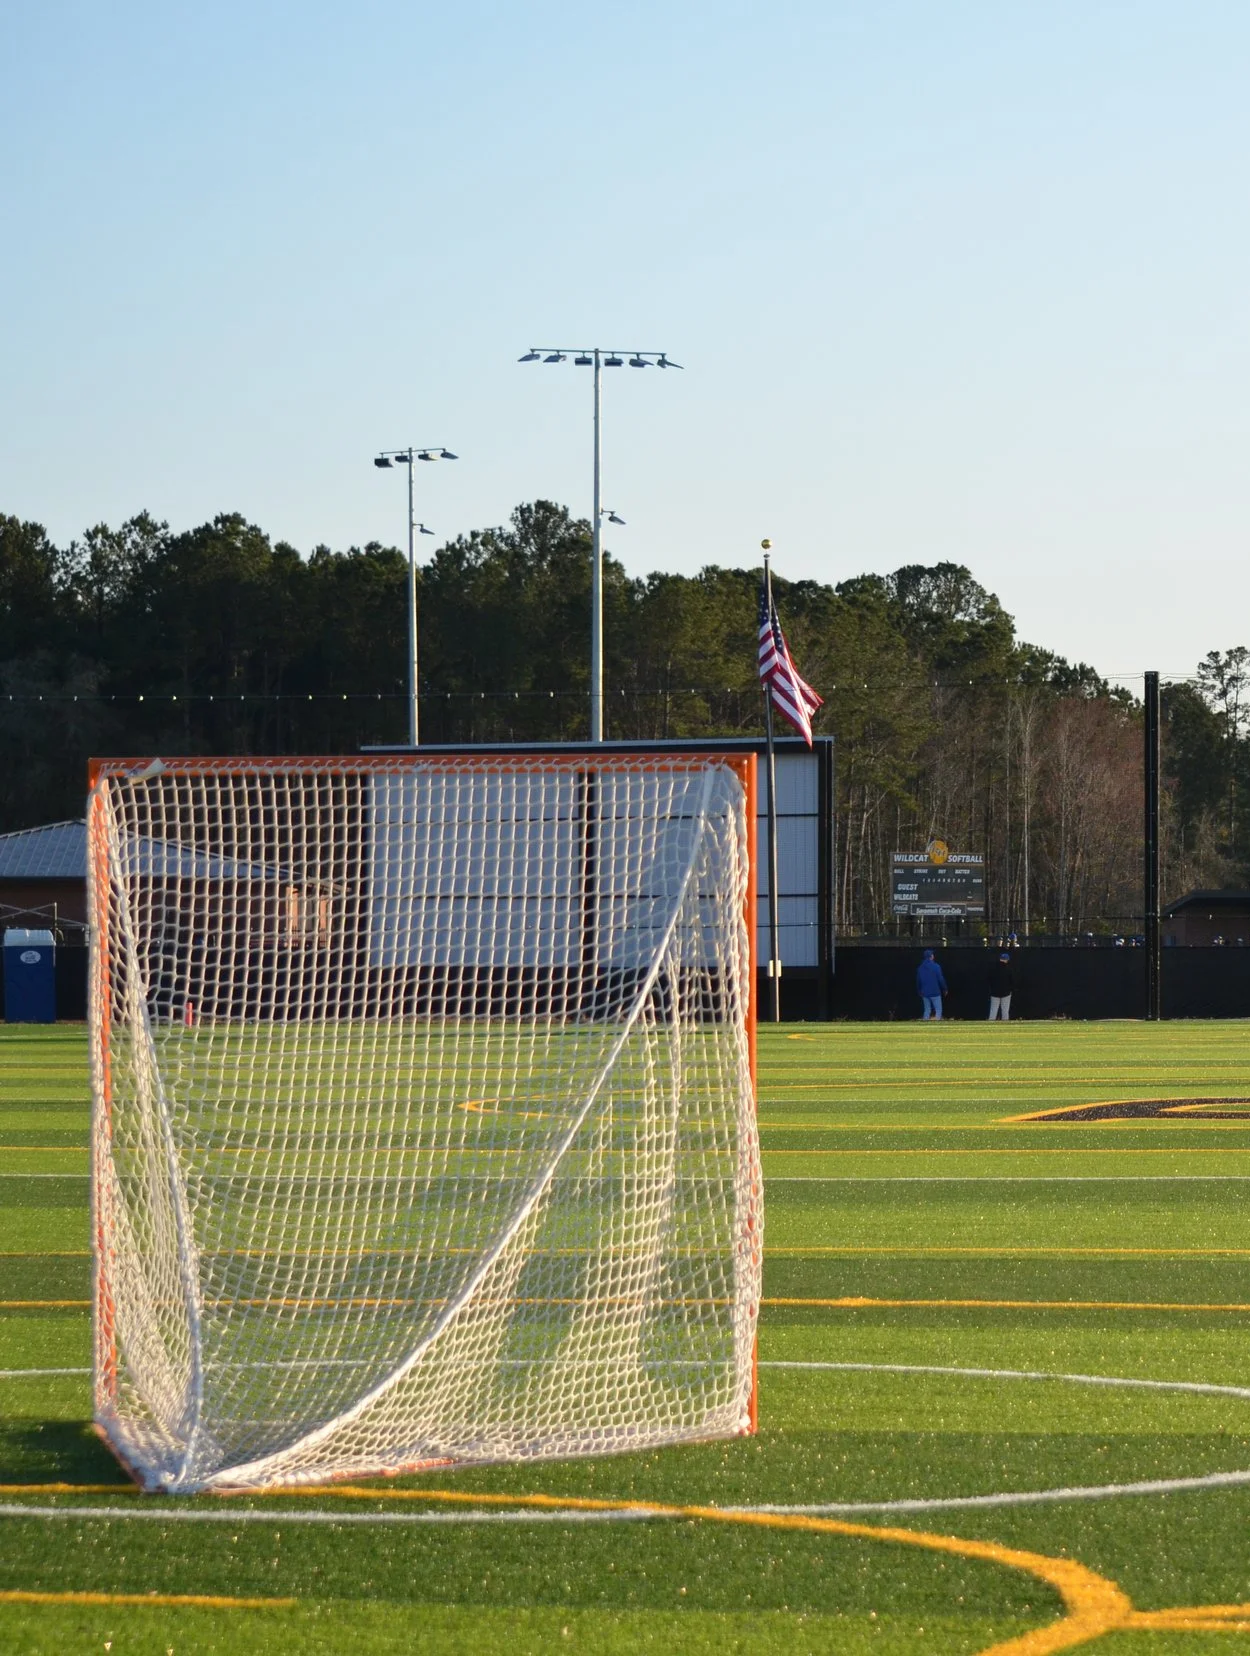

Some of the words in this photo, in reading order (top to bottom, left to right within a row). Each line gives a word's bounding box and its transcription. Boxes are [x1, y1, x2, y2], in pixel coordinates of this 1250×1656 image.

[893, 854, 929, 862] WILDCAT
[947, 855, 983, 863] SOFTBALL
[897, 883, 919, 891] GUEST
